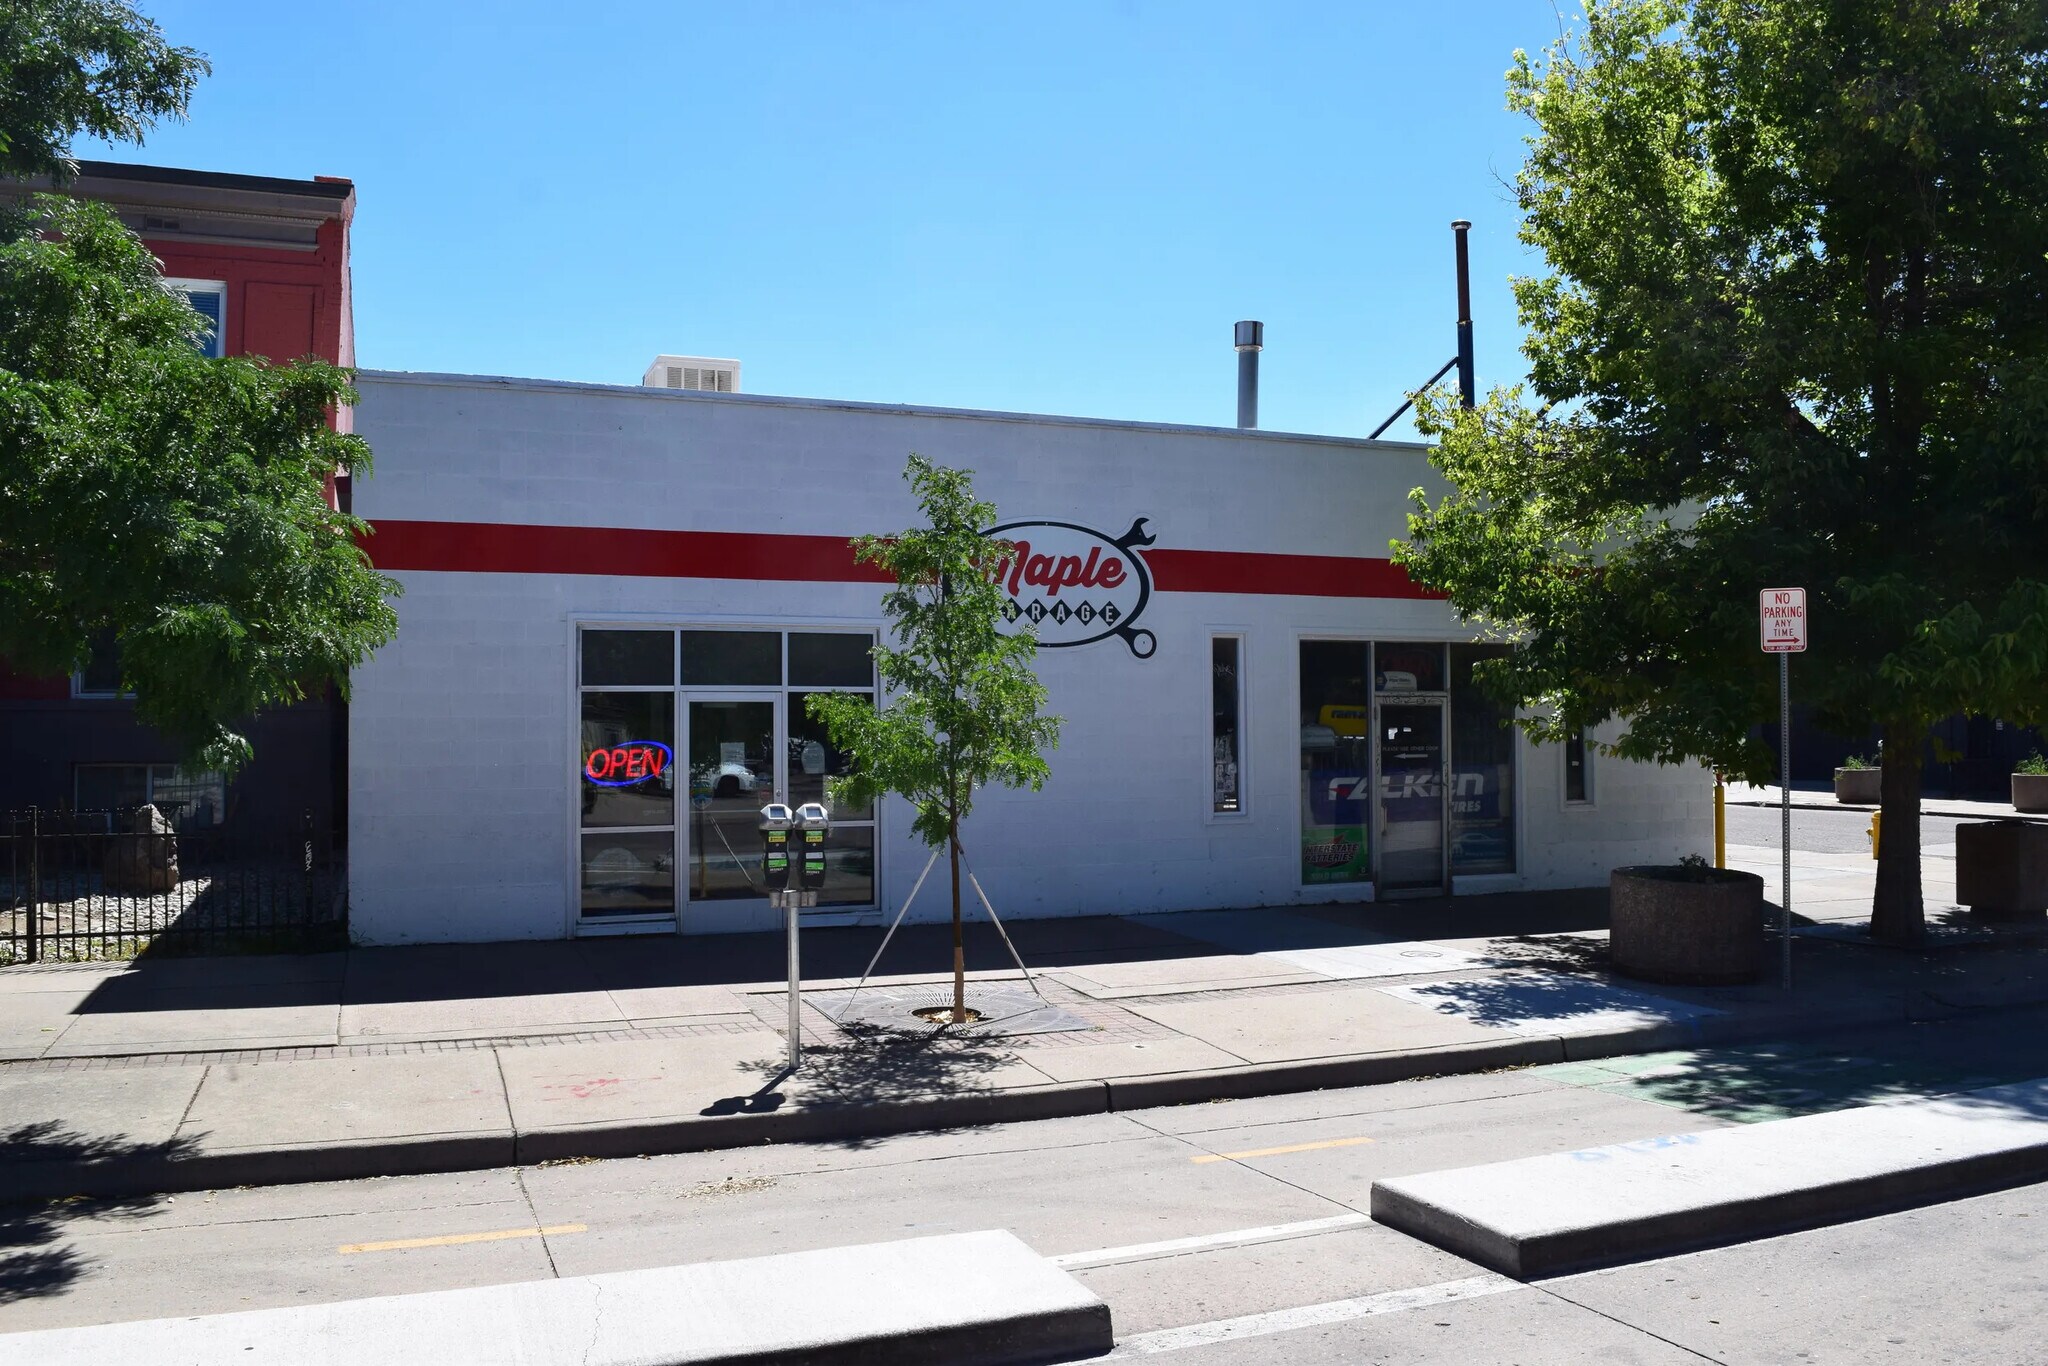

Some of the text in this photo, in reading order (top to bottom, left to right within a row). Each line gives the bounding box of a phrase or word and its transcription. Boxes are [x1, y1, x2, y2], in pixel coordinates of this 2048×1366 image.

[1775, 593, 1790, 604] NO
[1003, 603, 1115, 623] ARAGE
[1764, 606, 1802, 618] PARKING
[1774, 628, 1794, 636] TIME
[587, 747, 664, 778] OPEN
[1304, 843, 1360, 854] INTERSTATE
[1304, 853, 1354, 863] BATTERIES
